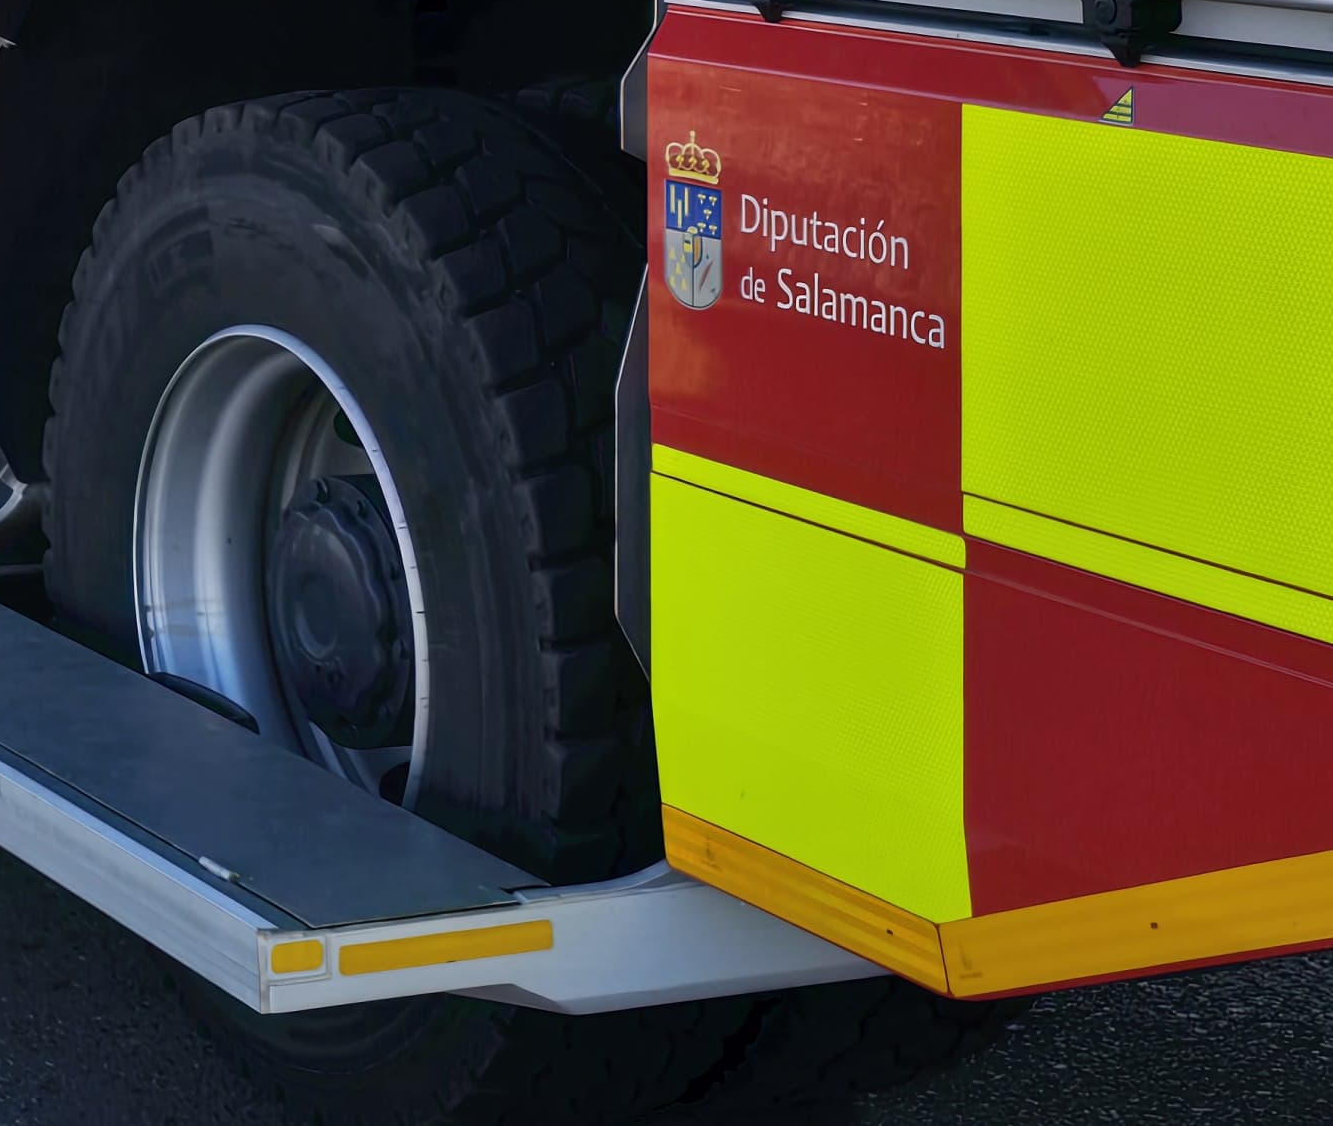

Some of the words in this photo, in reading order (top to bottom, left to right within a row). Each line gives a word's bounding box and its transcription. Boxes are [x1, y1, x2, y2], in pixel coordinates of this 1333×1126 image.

[740, 194, 909, 270] Diputación
[740, 266, 766, 304] de
[776, 267, 945, 349] Salamanca
